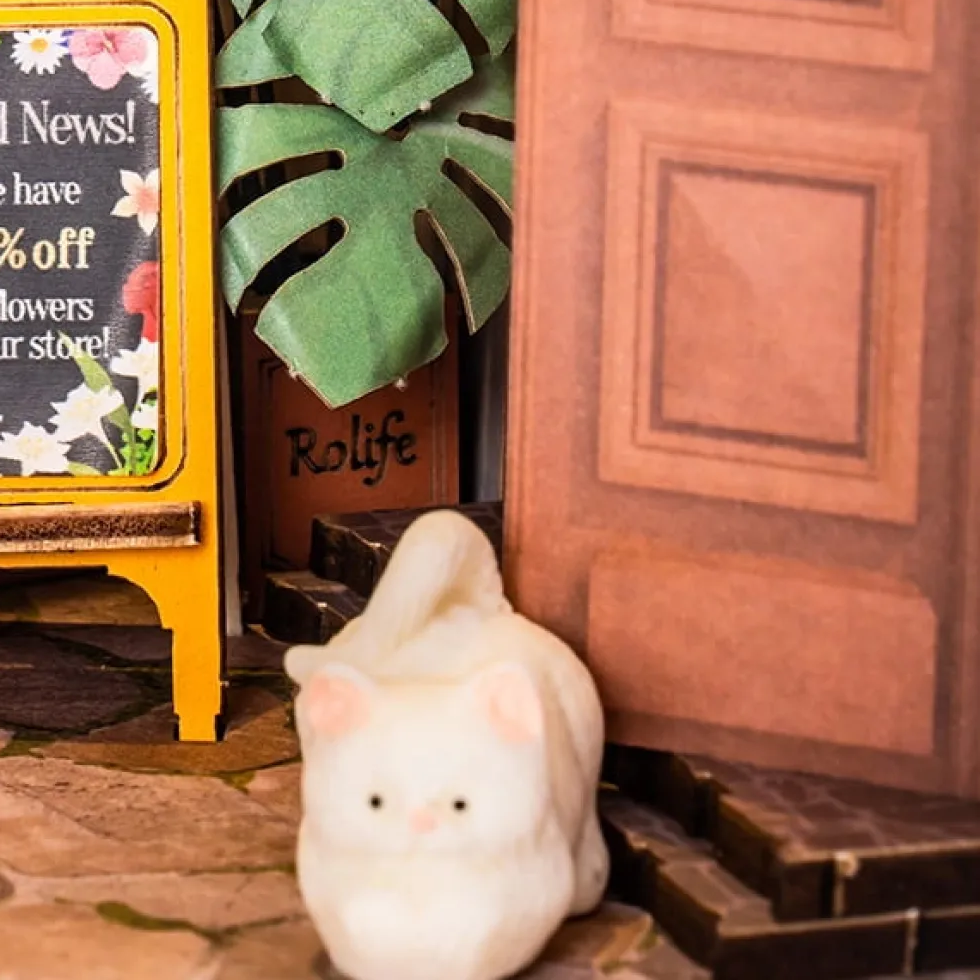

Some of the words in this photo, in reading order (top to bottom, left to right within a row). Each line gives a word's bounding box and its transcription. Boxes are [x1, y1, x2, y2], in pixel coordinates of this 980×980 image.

[20, 98, 136, 146] News!
[12, 171, 82, 206] have
[32, 226, 96, 271] off
[28, 325, 110, 361] store!
[285, 409, 417, 487] Rolife
